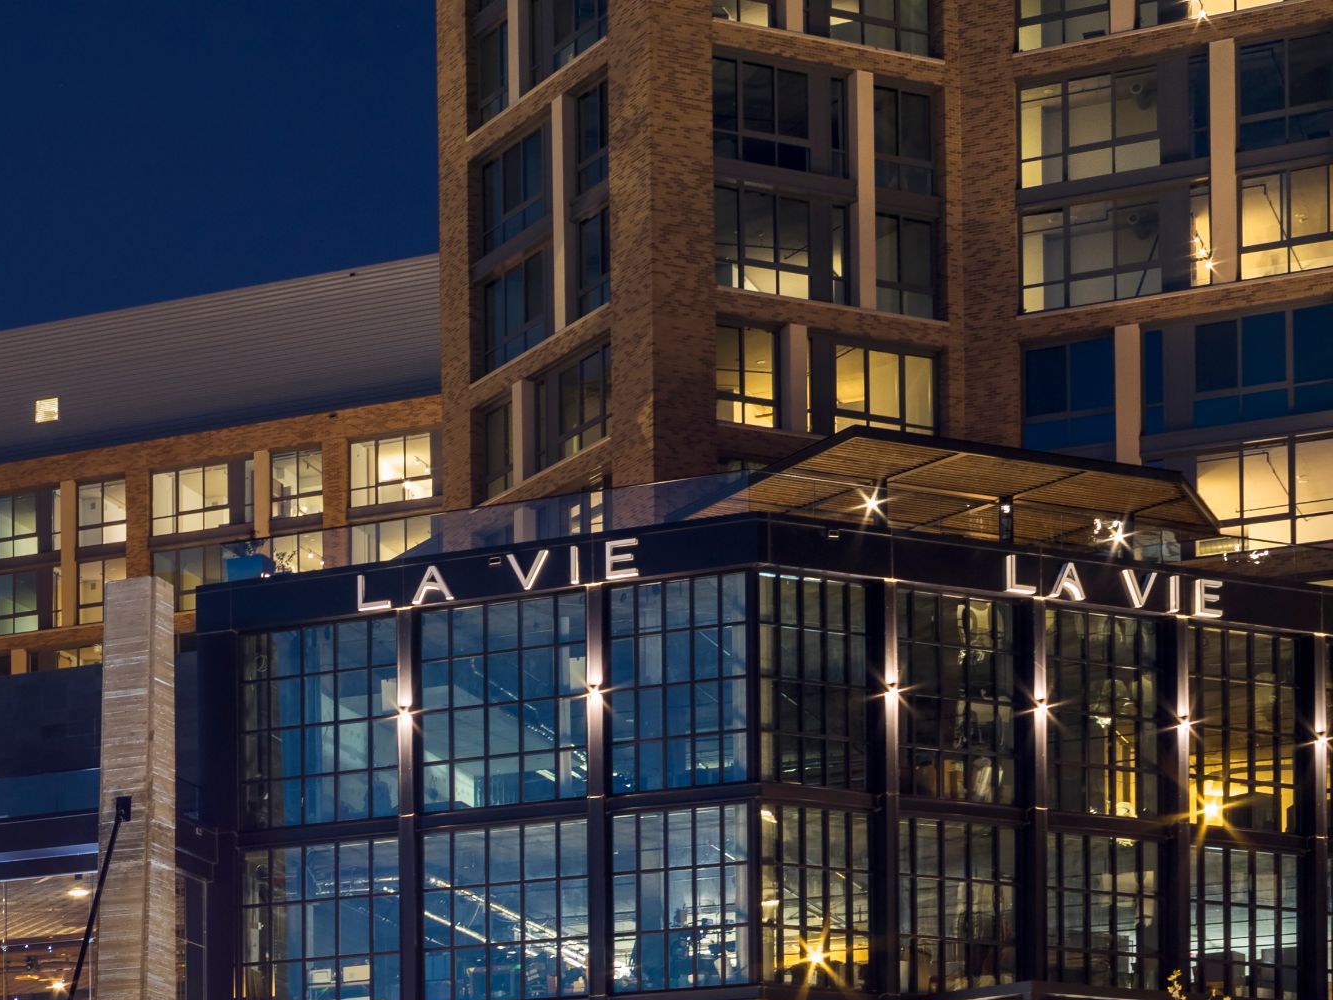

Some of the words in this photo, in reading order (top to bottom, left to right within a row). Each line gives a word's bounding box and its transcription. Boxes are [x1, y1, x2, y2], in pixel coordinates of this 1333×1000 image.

[357, 564, 454, 612] LA
[506, 538, 639, 590] VIE
[1005, 554, 1086, 602] LA
[1121, 569, 1224, 618] VIE
